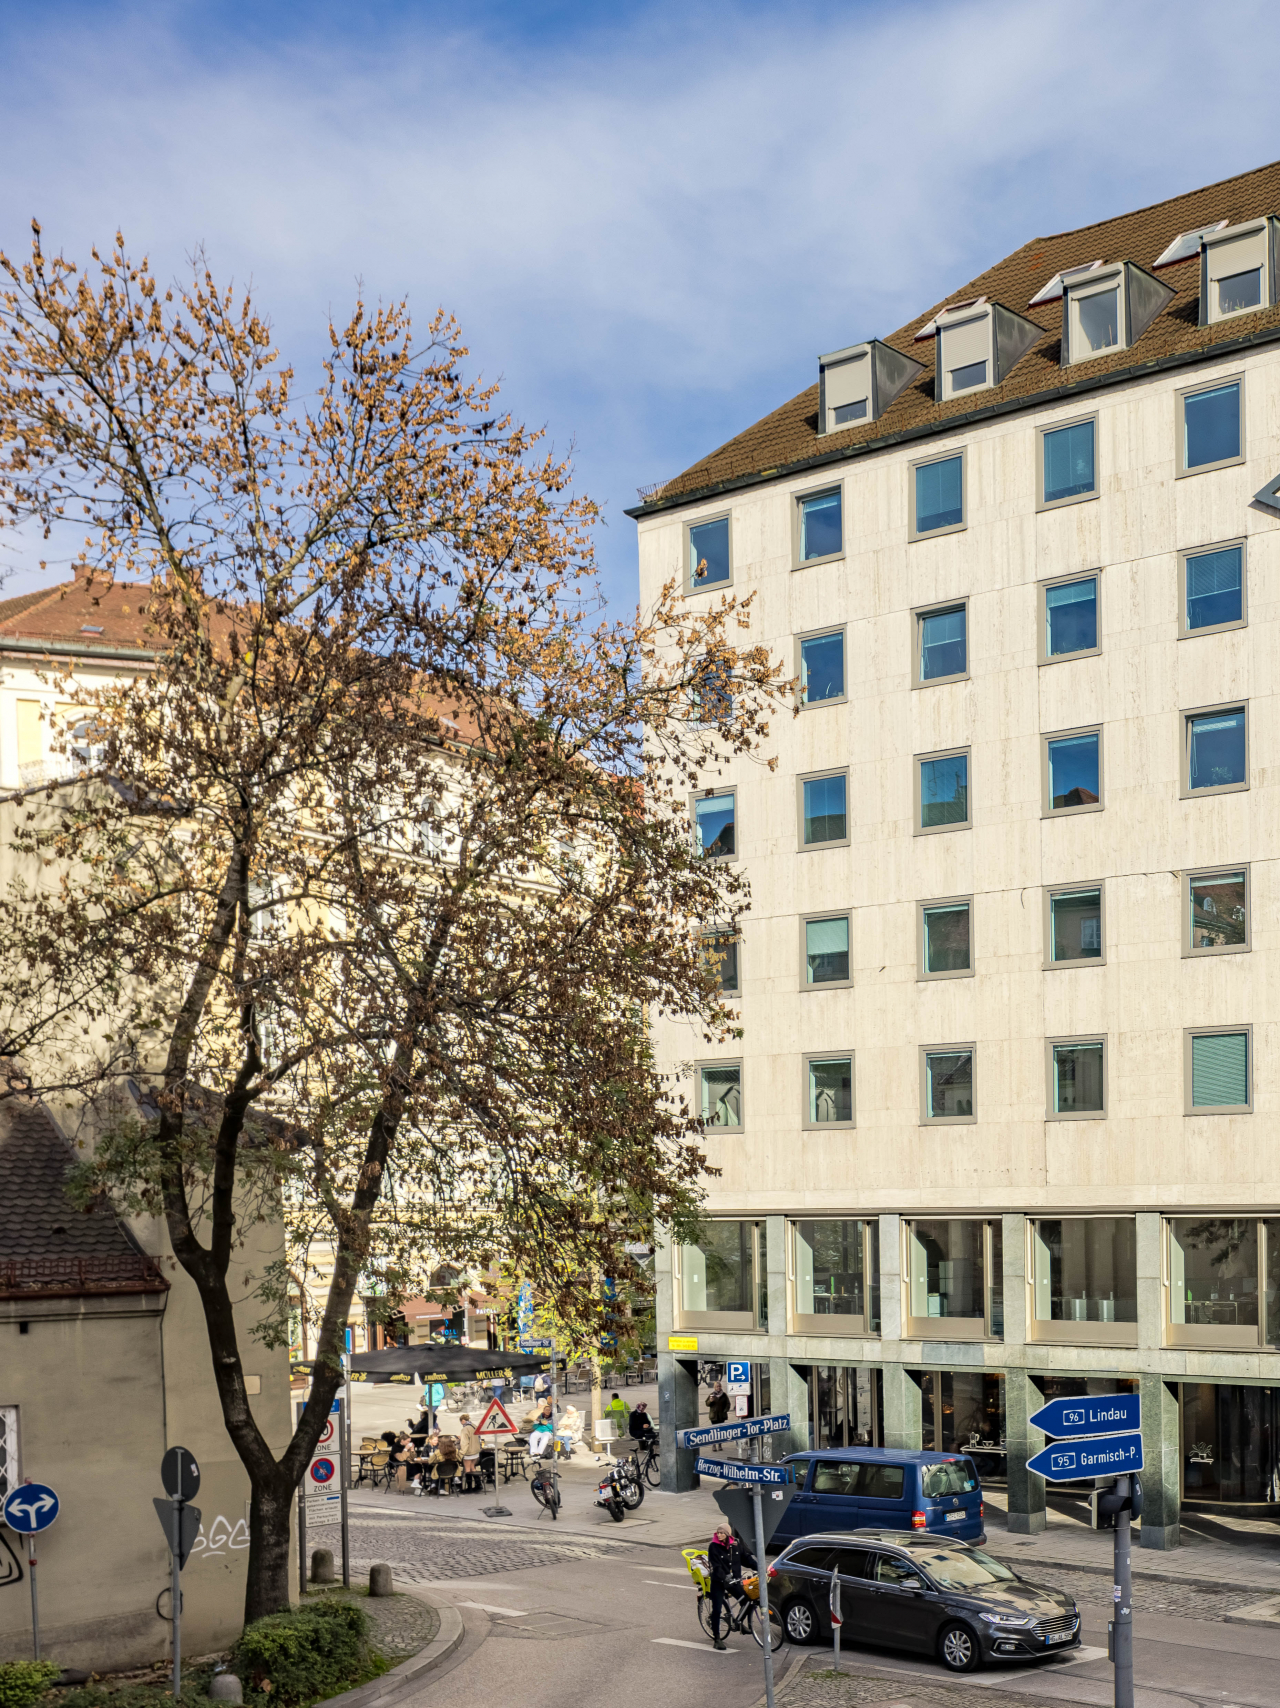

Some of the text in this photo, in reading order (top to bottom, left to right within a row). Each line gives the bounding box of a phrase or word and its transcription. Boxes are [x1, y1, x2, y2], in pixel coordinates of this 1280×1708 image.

[1069, 1408, 1127, 1423] 96 Lindau
[689, 1418, 788, 1446] Sendlinger-Tor-Platz
[1057, 1446, 1139, 1467] 95 Garmisch-P.
[697, 1458, 781, 1483] Herzog-Wilhelm-Str.
[314, 1484, 332, 1492] ZONE
